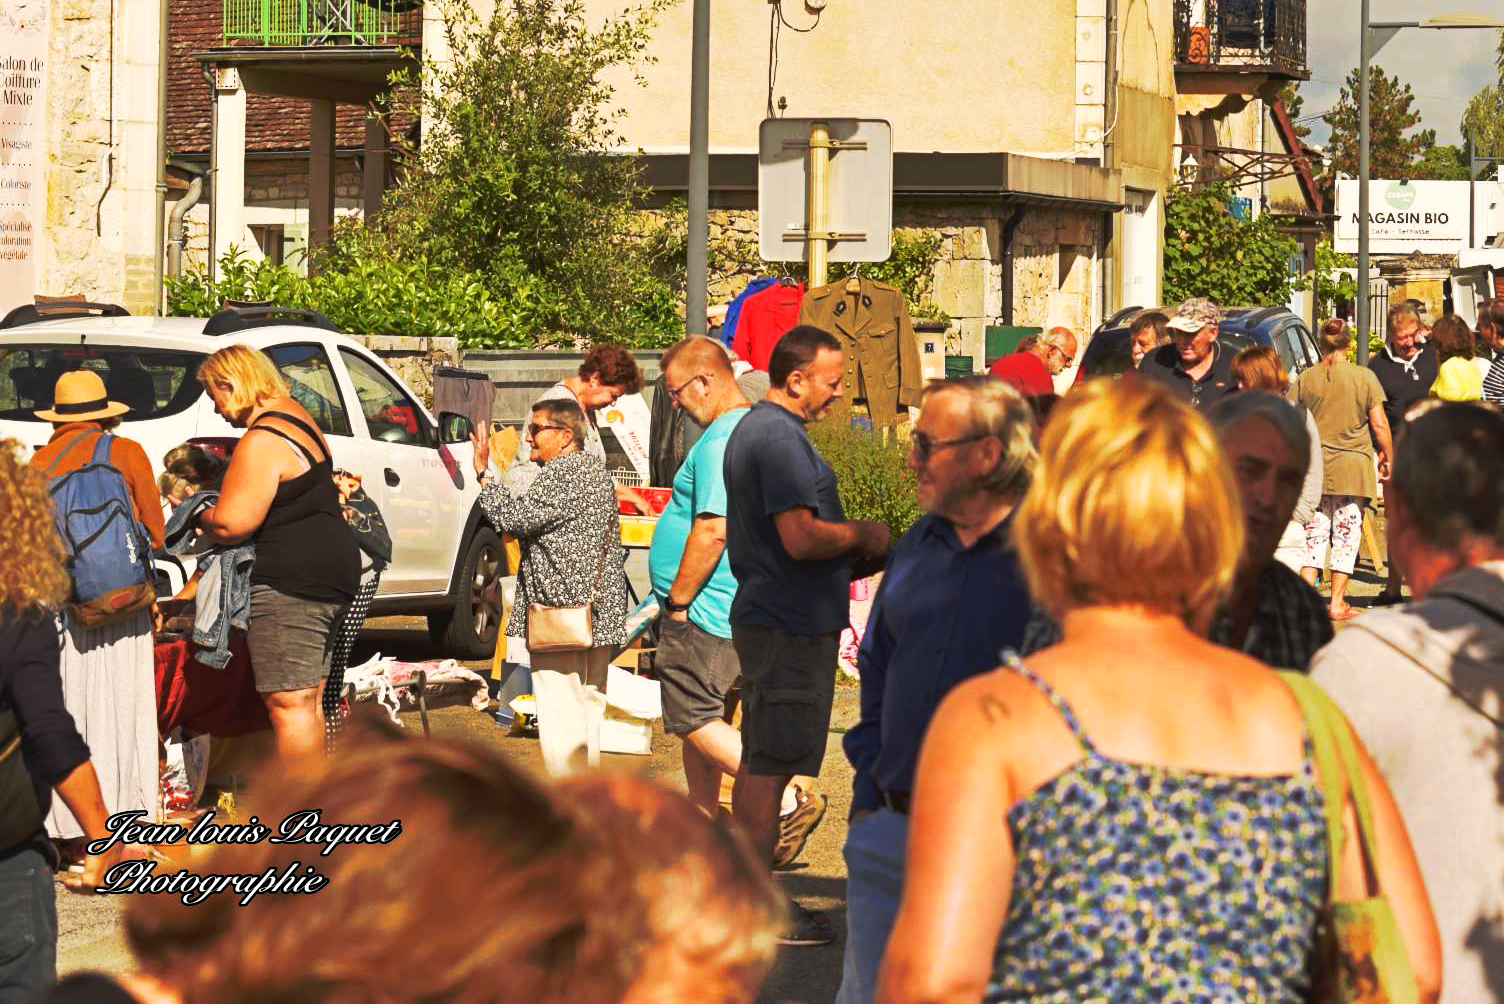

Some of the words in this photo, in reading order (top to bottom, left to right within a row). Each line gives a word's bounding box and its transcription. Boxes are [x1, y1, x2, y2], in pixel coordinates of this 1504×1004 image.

[0, 56, 26, 71] alon
[30, 57, 44, 71] de
[4, 89, 33, 105] Mixte
[1, 137, 32, 149] Visagiste
[1424, 212, 1449, 224] BIO
